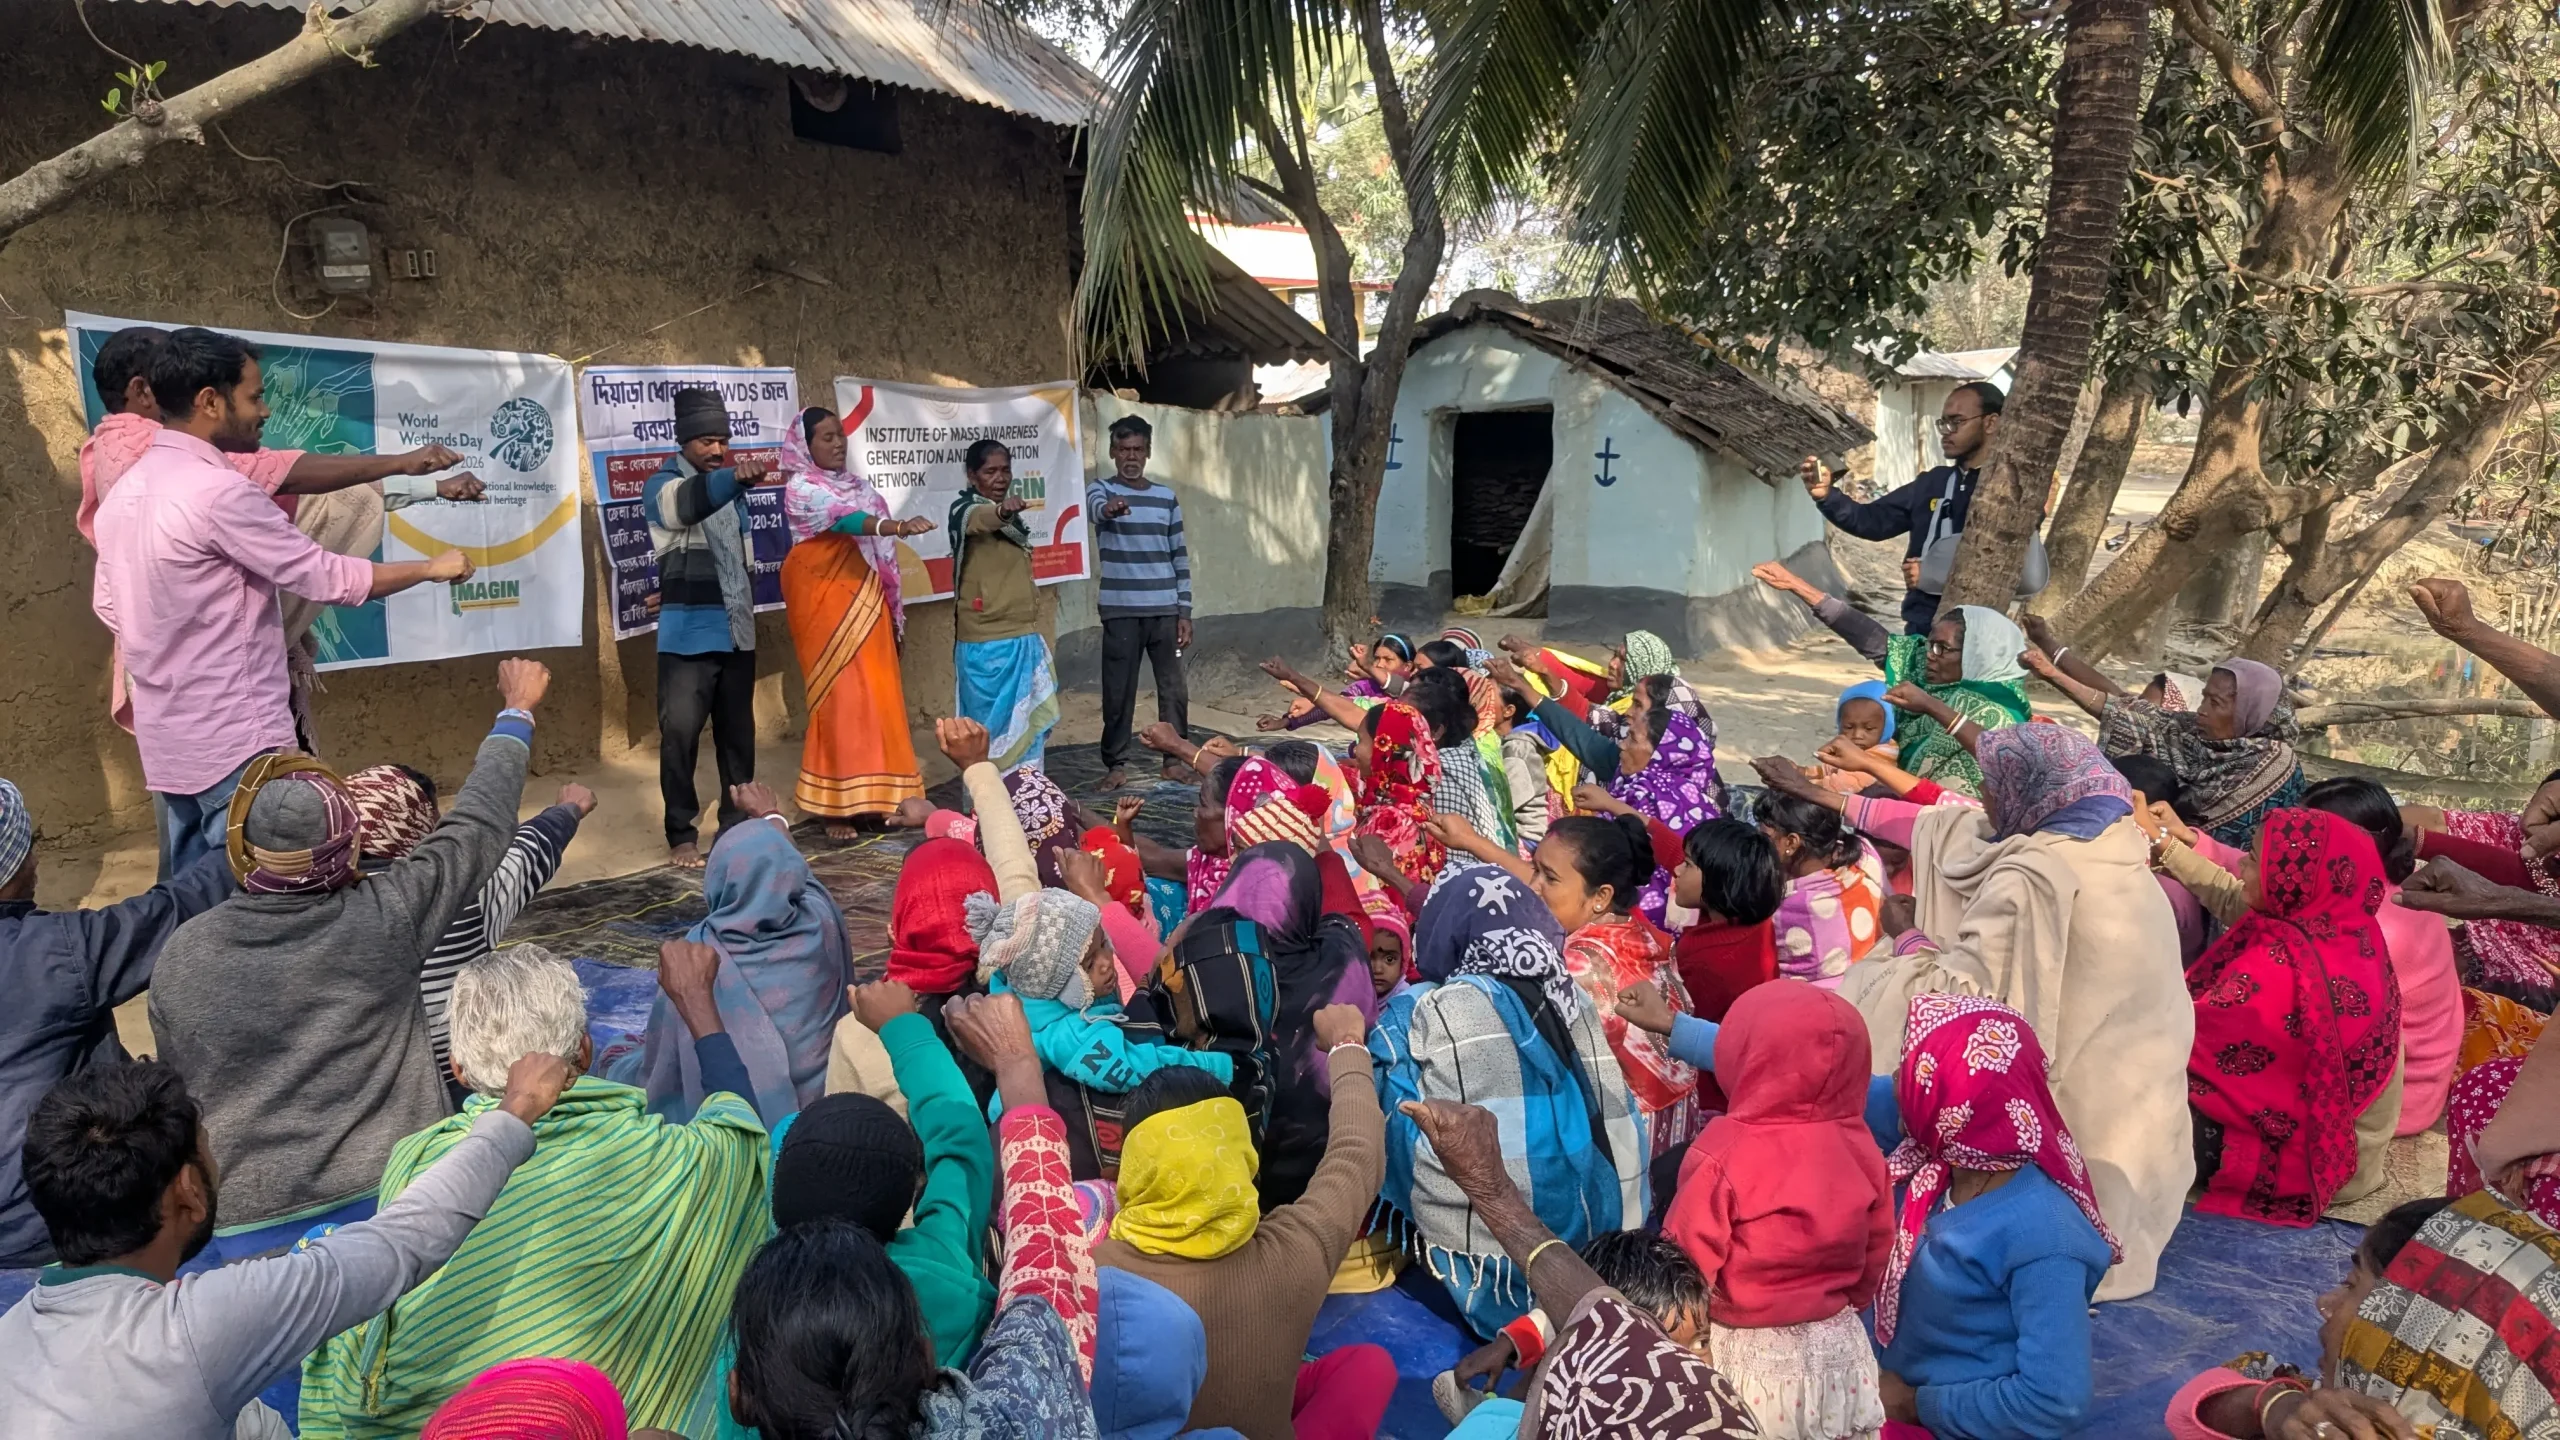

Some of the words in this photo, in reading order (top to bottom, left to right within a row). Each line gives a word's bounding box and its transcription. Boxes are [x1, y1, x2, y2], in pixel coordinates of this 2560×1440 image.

[593, 376, 644, 409] দিয়াড়া
[721, 382, 759, 402] WDS
[760, 381, 789, 401] জল
[398, 412, 439, 428] World
[400, 431, 458, 446] Wetlands
[459, 432, 484, 452] Day
[866, 427, 929, 443] INSTITUTE
[932, 427, 948, 442] OF
[950, 426, 981, 441] MASS
[983, 424, 1039, 441] AWARENESS
[461, 456, 484, 469] 2026
[866, 448, 944, 465] GENERATION
[946, 449, 970, 464] AND
[1008, 445, 1039, 460] ATION
[484, 481, 511, 491] itional
[513, 481, 557, 493] knowledge:
[868, 471, 928, 489] NETWORK
[1008, 476, 1046, 499] GIN
[494, 494, 528, 507] heritage
